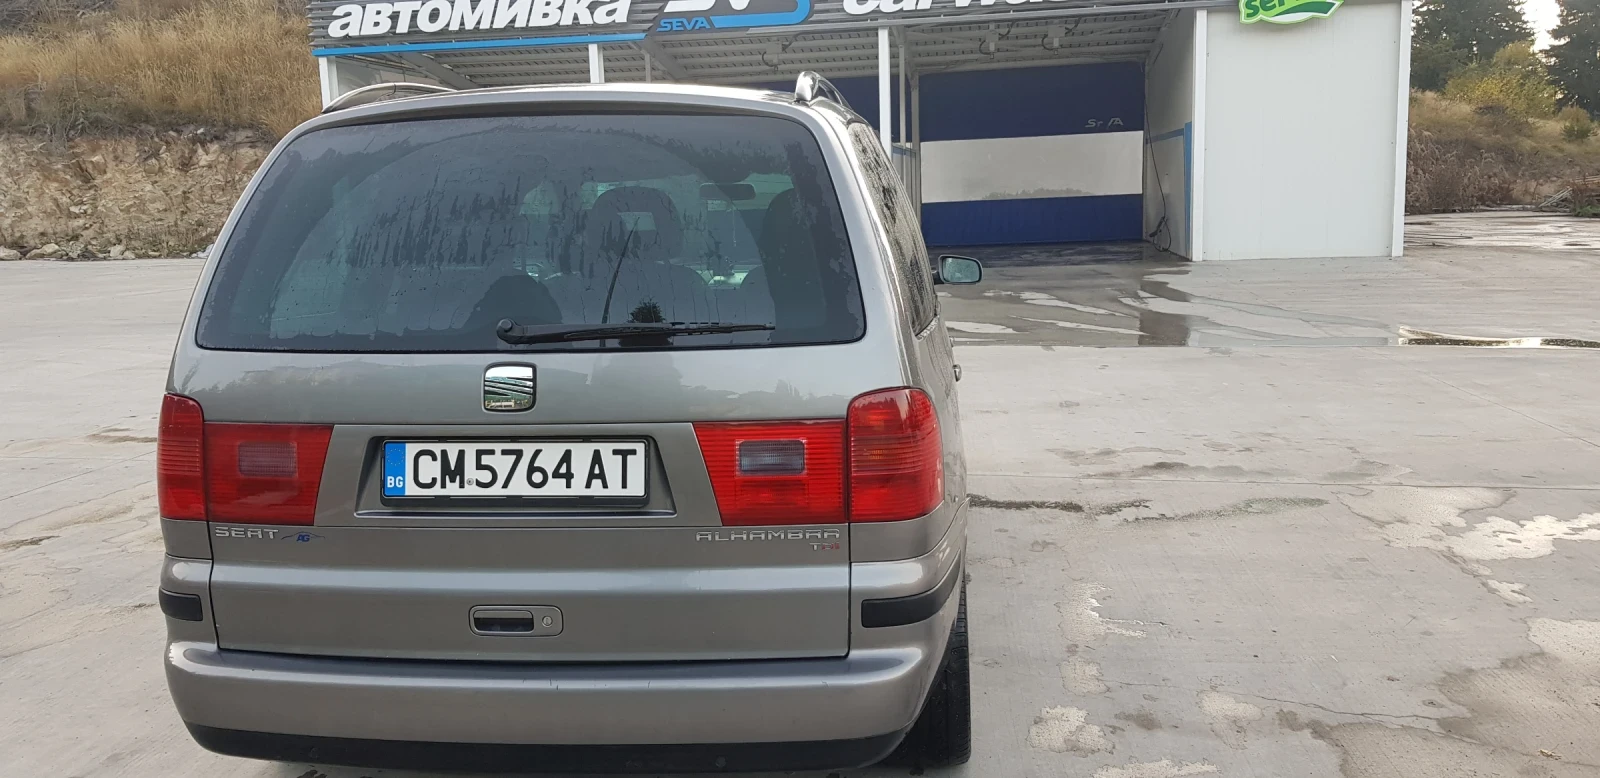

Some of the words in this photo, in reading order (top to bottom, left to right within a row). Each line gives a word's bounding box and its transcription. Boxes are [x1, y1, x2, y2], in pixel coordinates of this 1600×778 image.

[327, 0, 632, 37] автомивка
[656, 16, 711, 32] SEVA
[474, 449, 575, 489] 5764
[584, 449, 637, 489] AT
[386, 476, 404, 488] BG
[215, 526, 279, 539] SEAT
[695, 529, 841, 542] ALHAMBRA
